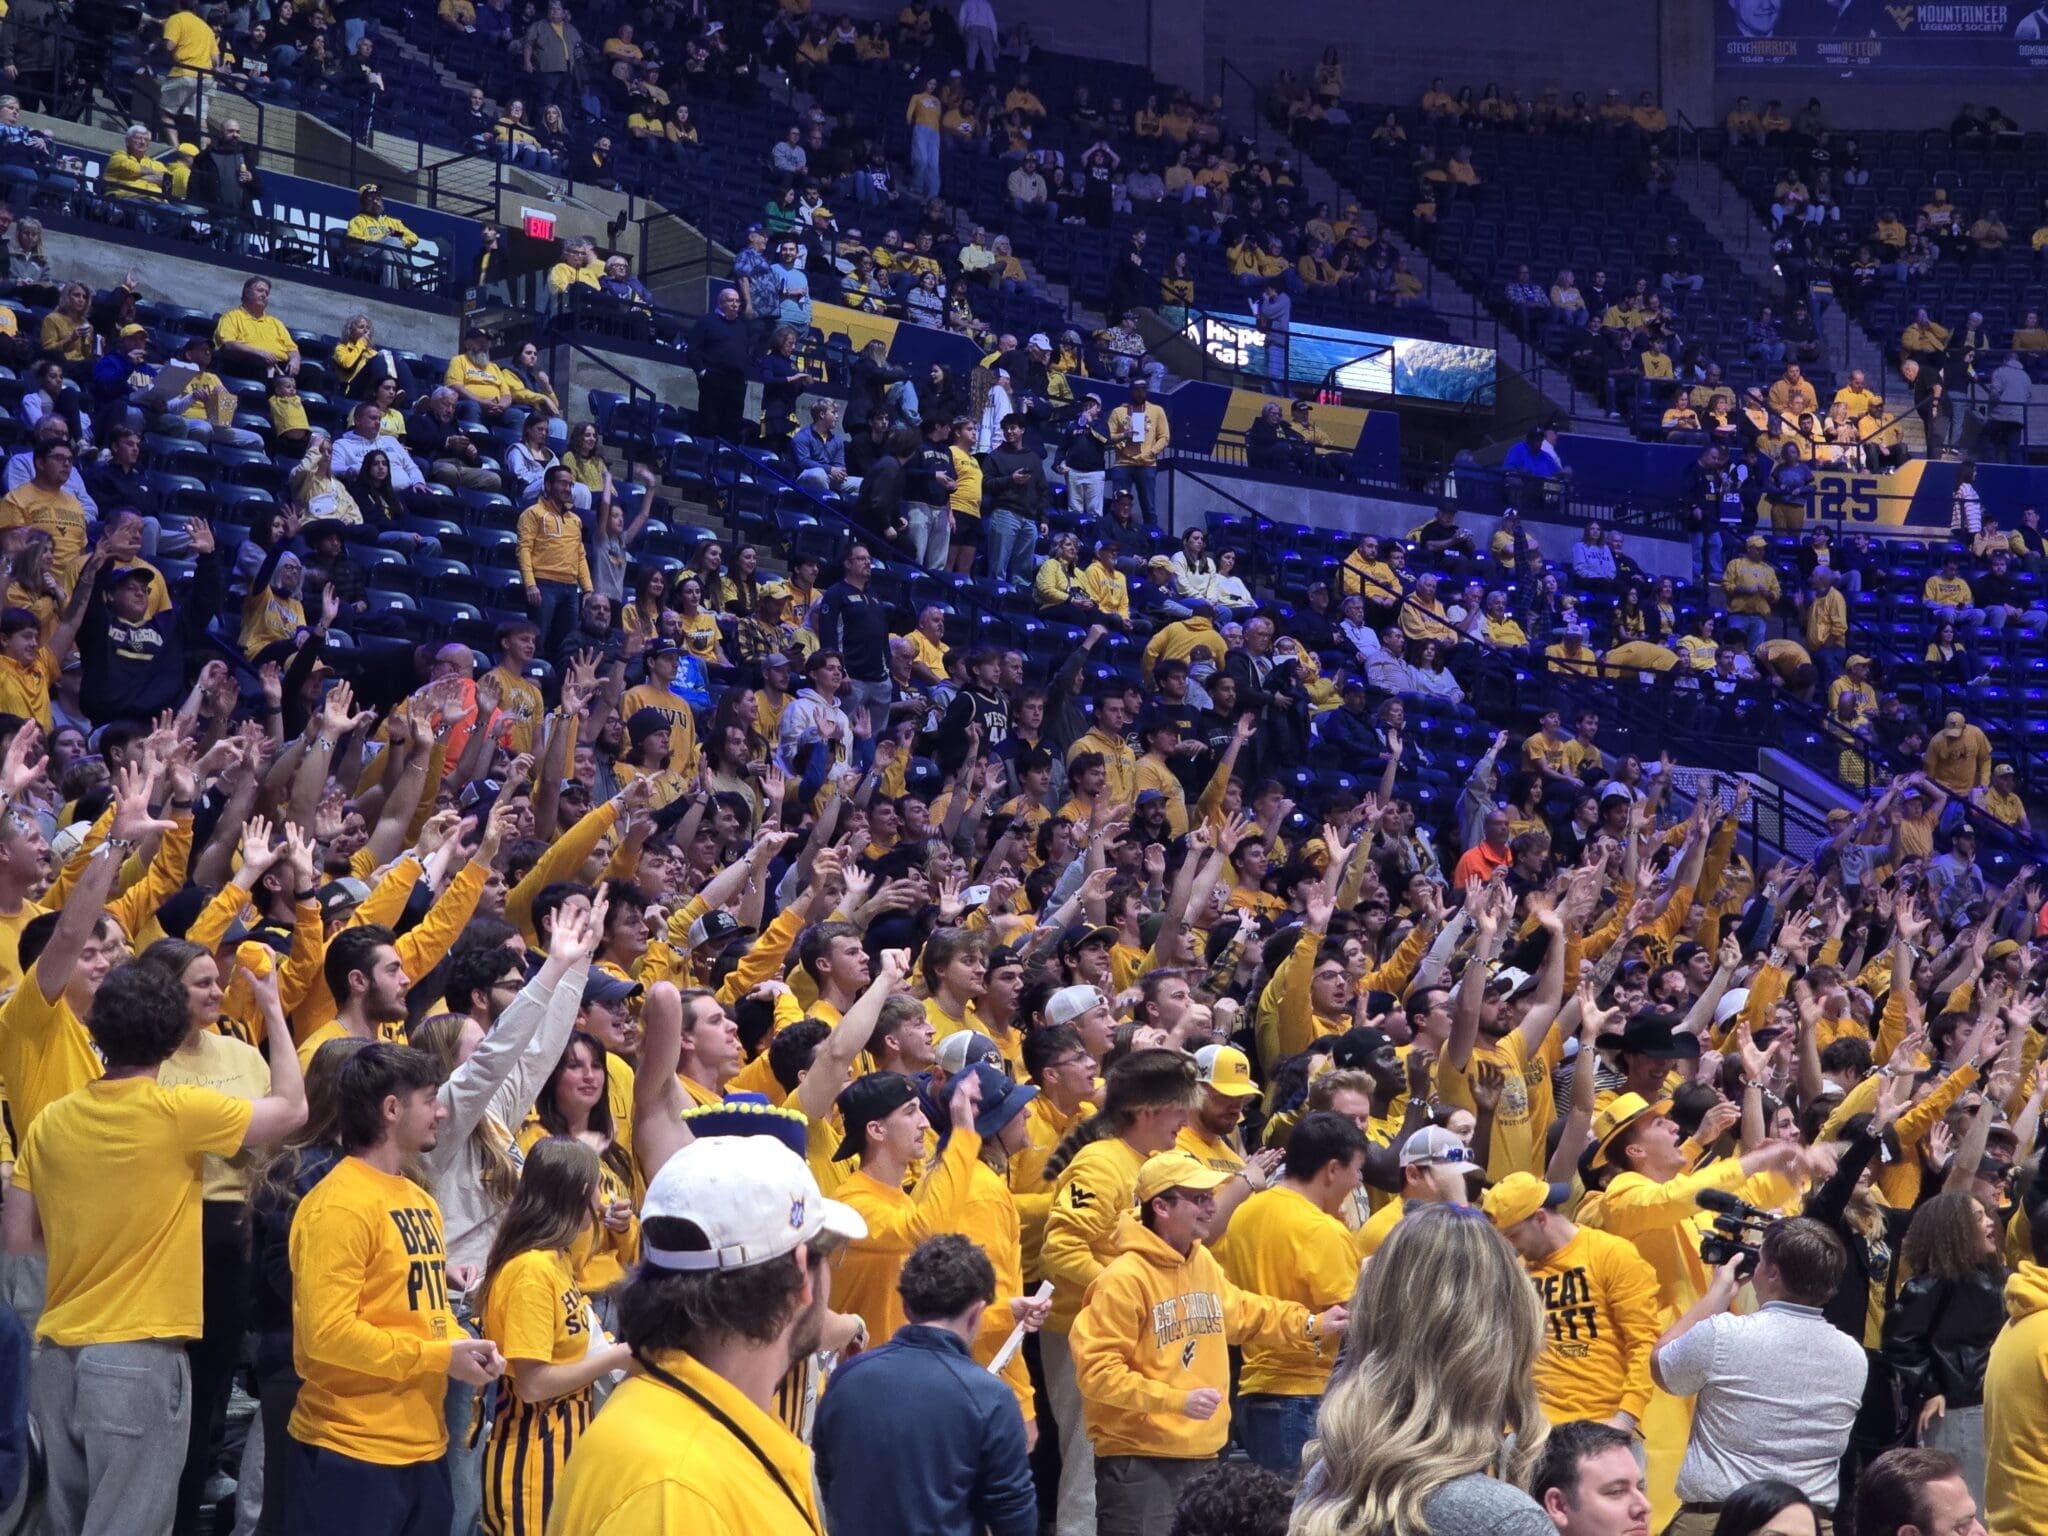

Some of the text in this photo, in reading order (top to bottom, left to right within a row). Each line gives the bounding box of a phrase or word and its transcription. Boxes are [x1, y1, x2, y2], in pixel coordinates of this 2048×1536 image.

[1917, 5, 2007, 23] MOUNTAINEER
[1920, 23, 2003, 32] LEGENDS SOCIETY
[530, 216, 552, 240] EXIT
[1206, 318, 1266, 347] Hope
[1206, 341, 1249, 366] Gas
[984, 711, 1008, 730] WEST
[390, 1207, 446, 1256] BEAT
[1549, 1305, 1599, 1342] ITT
